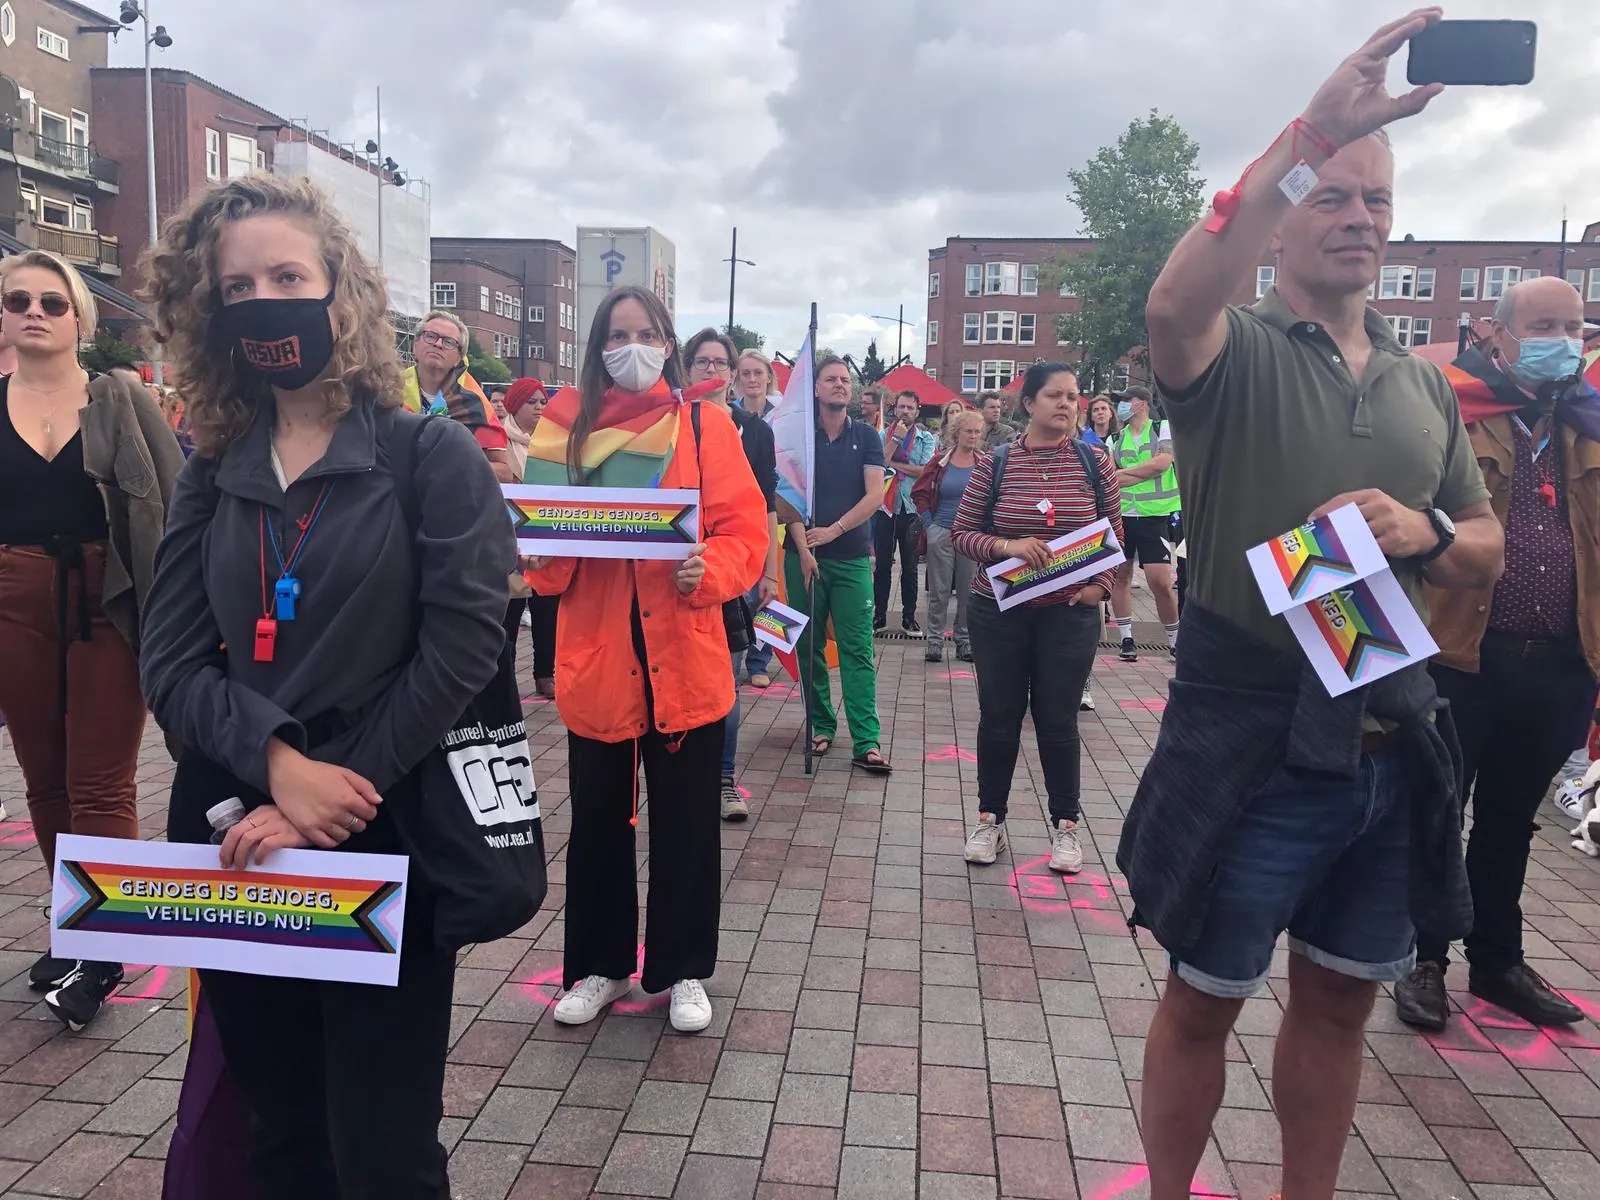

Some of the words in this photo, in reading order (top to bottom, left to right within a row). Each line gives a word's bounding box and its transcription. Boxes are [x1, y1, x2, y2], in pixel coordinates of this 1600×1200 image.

[537, 507, 589, 519] GENOEG
[593, 510, 605, 519] IS
[608, 510, 663, 522] GENOEG,
[552, 522, 621, 533] VEILIGHEID
[623, 525, 648, 533] NU!
[1028, 559, 1074, 582] VEILIGHEID
[1075, 554, 1090, 564] NU!
[119, 880, 211, 899] GENOEG
[218, 884, 238, 901] IS
[244, 886, 339, 911] GENOEG,
[145, 905, 268, 927] VEILIGHEID
[274, 913, 312, 931] NU!
